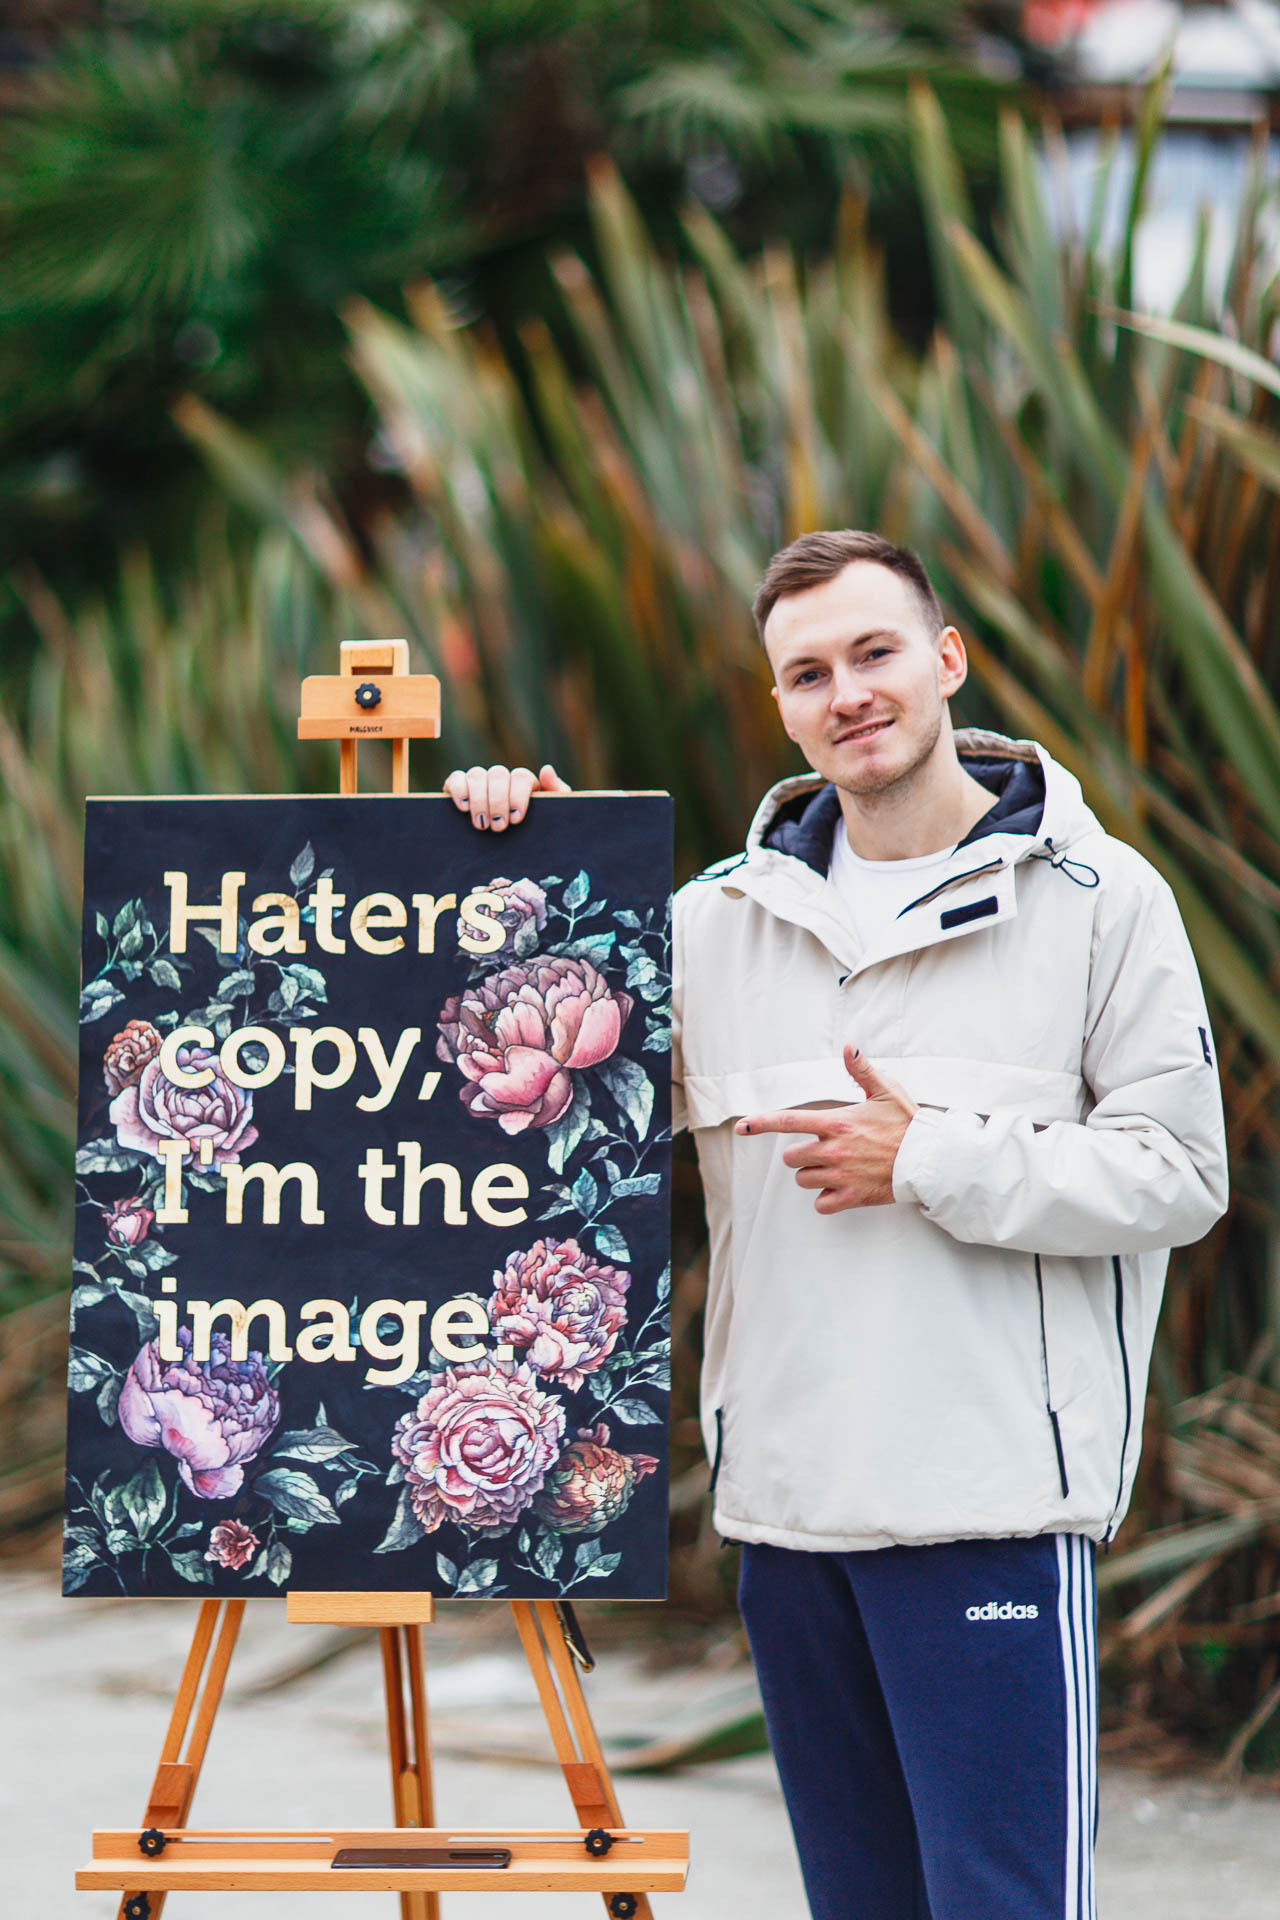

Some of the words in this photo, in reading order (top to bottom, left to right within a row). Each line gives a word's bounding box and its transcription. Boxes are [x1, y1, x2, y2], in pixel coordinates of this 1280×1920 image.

[163, 871, 507, 955] Haters
[159, 1026, 442, 1112] copy,
[155, 1139, 325, 1225] I'm
[358, 1141, 530, 1226] the
[153, 1277, 515, 1385] image.
[965, 1601, 1039, 1621] adidas
